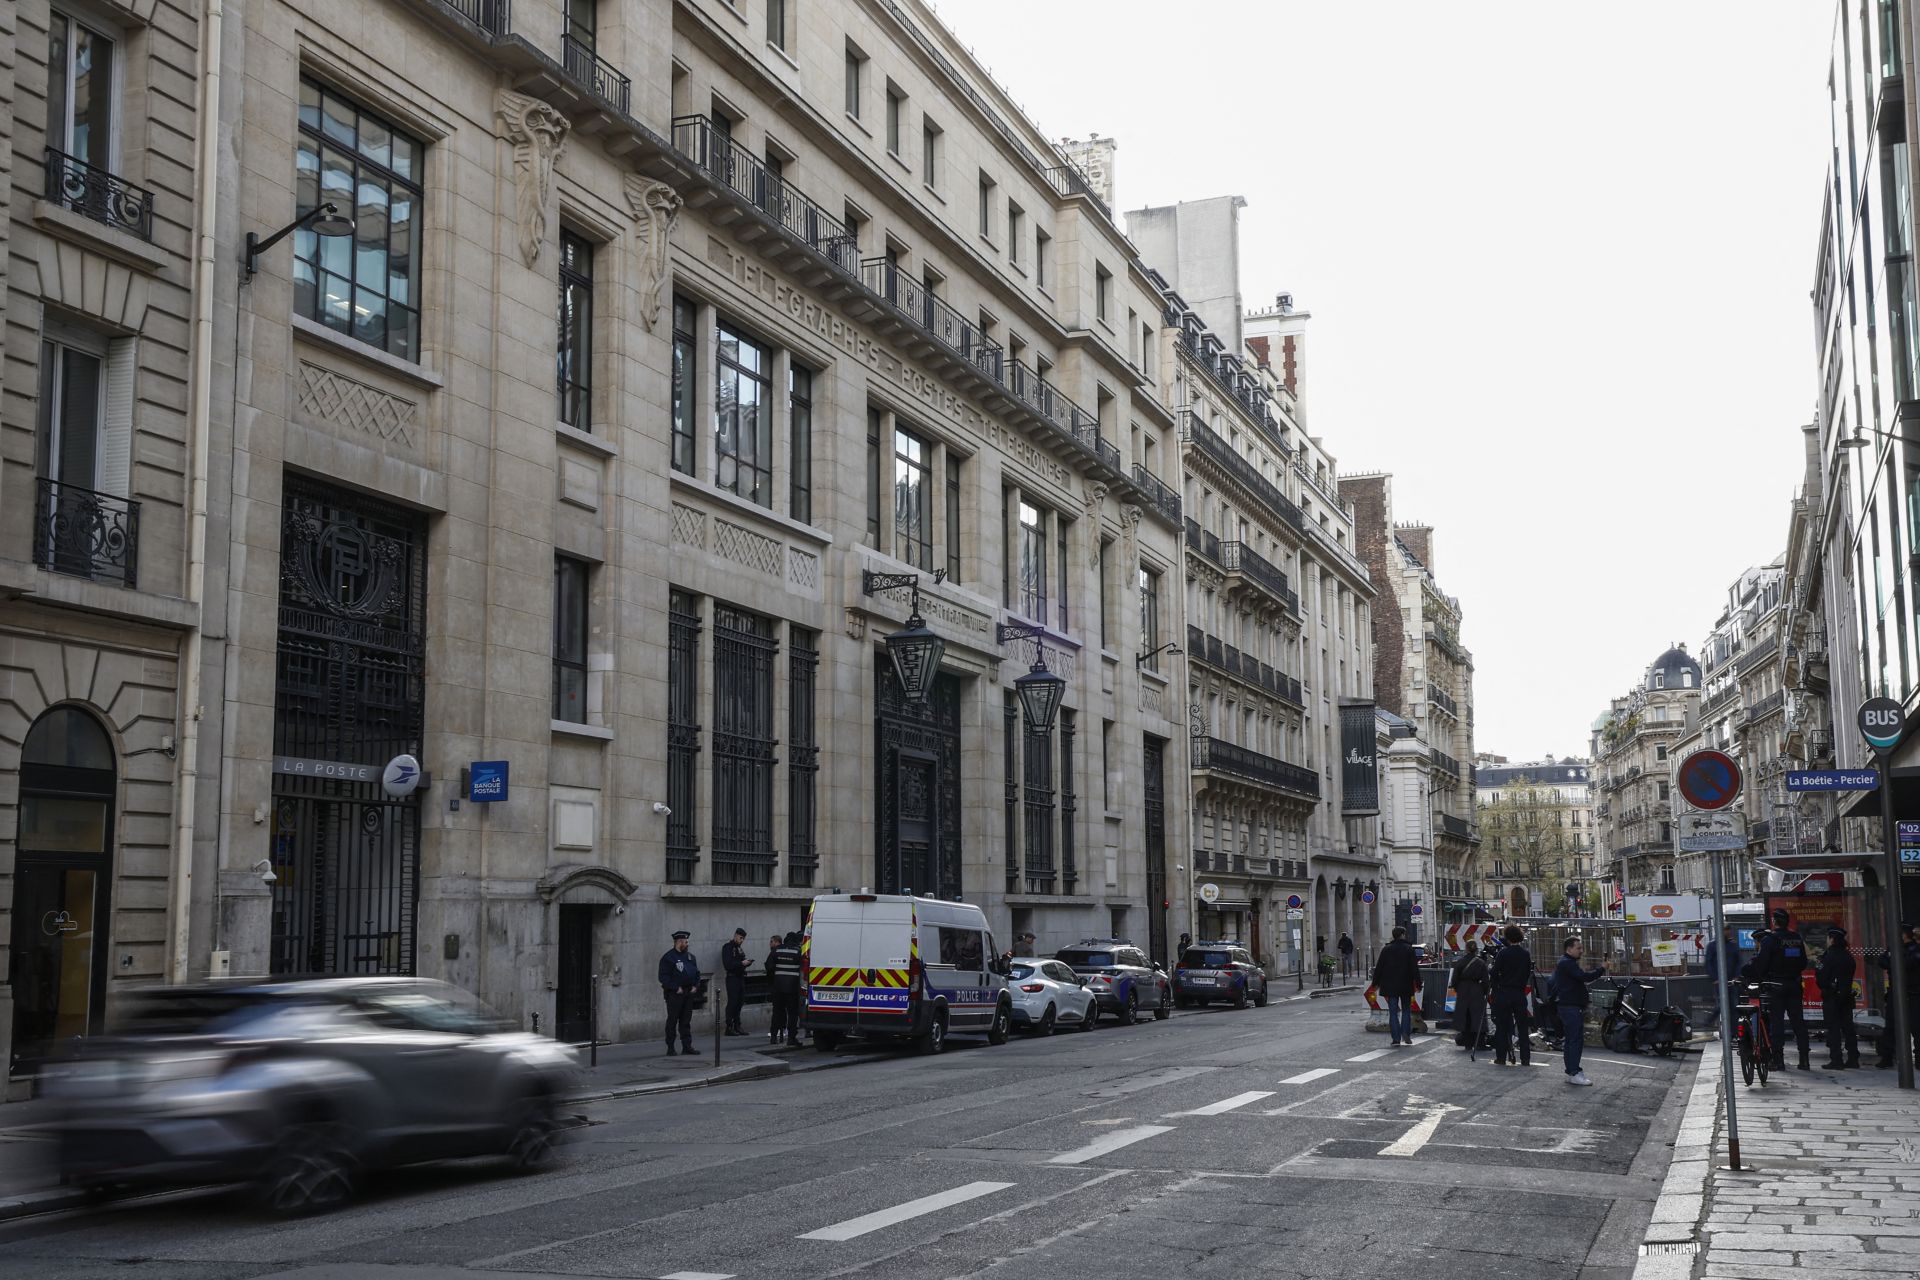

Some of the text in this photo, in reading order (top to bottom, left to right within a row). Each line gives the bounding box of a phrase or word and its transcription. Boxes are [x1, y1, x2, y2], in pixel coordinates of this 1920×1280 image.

[901, 366, 963, 417] POSTES
[881, 587, 917, 608] BUREA
[925, 600, 962, 625] CENTRAL
[1865, 709, 1899, 726] BUS
[1345, 754, 1372, 764] VILLAGE
[283, 761, 367, 778] LA POSTE
[1789, 777, 1800, 786] La
[1803, 775, 1833, 785] Boétie
[1840, 775, 1874, 785] Percier
[1904, 850, 1919, 861] 52
[956, 990, 979, 1002] POLICE
